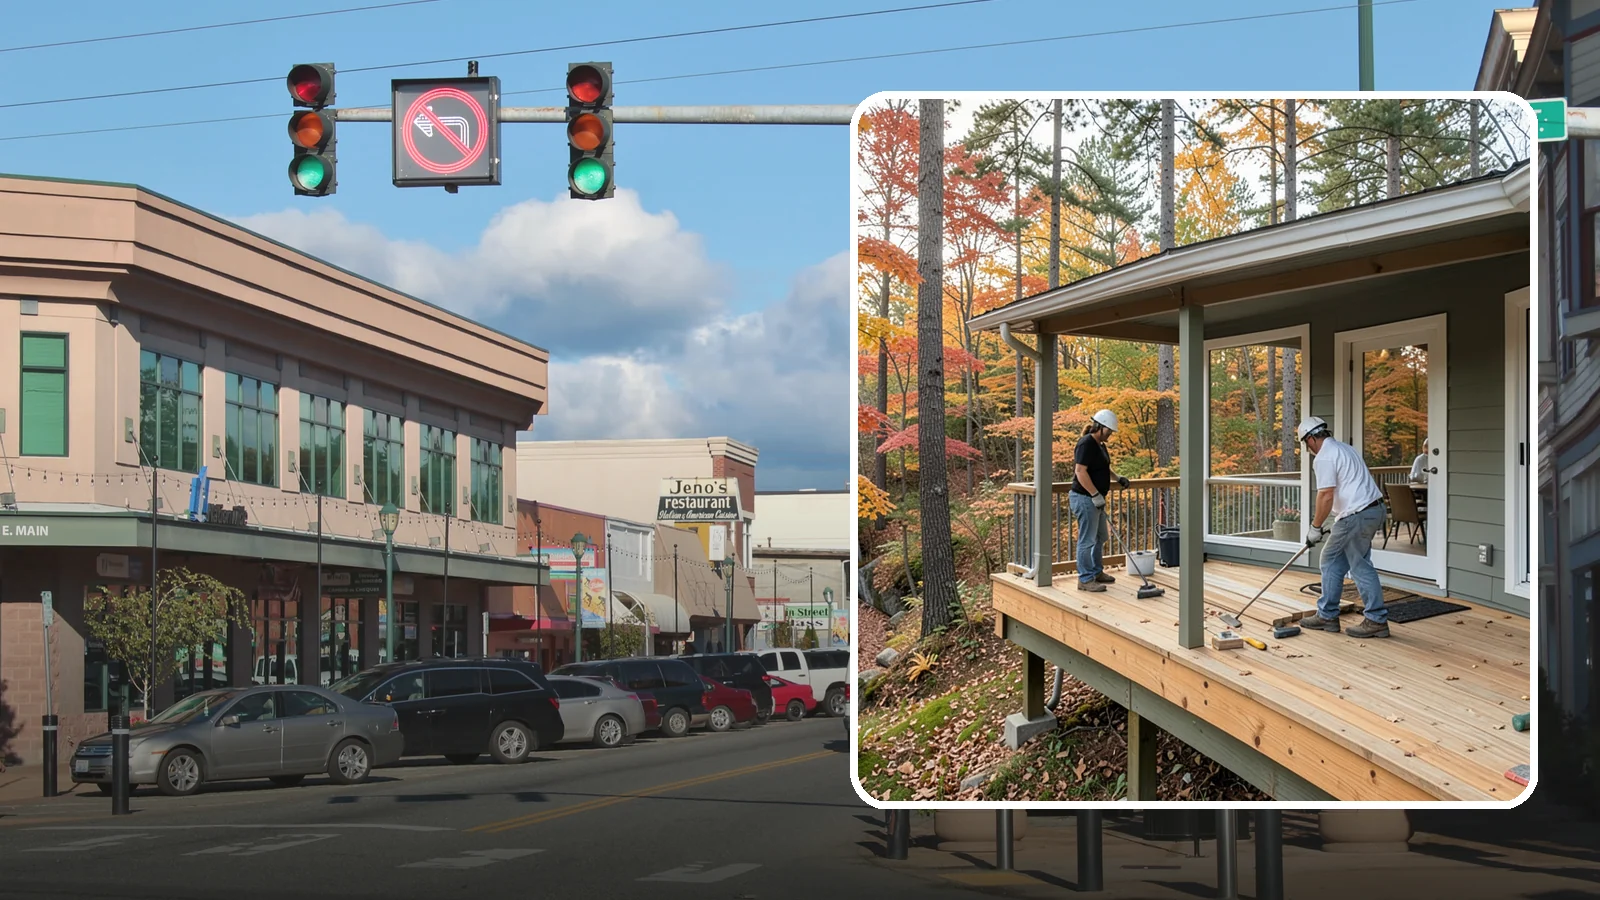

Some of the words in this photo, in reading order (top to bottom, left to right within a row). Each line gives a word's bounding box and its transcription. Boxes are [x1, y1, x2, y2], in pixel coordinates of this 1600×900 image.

[669, 480, 728, 495] Jeno's
[665, 496, 731, 509] restaurant
[658, 509, 682, 519] Italian
[686, 509, 715, 519] American
[715, 509, 738, 519] Cuisine
[2, 525, 13, 536] E.
[15, 525, 49, 536] MAIN
[797, 607, 828, 617] Street
[791, 619, 823, 627] lass
